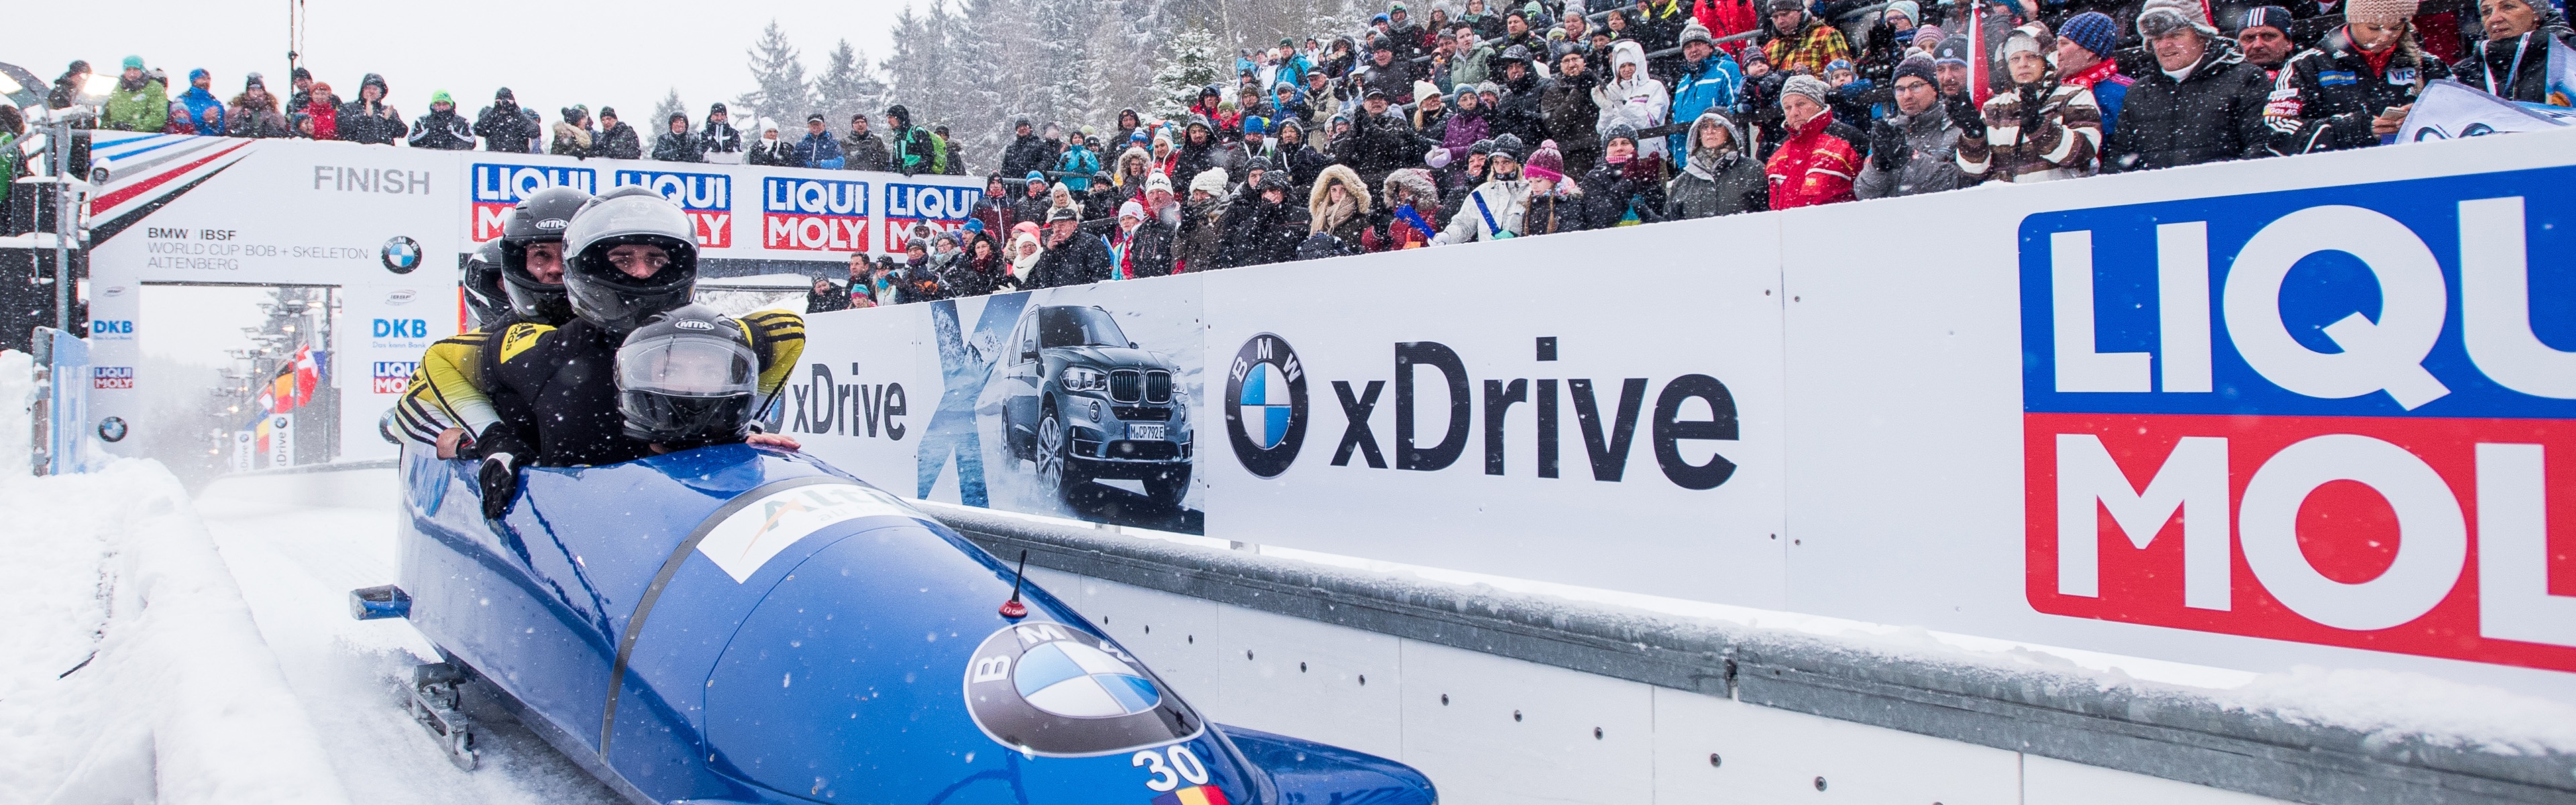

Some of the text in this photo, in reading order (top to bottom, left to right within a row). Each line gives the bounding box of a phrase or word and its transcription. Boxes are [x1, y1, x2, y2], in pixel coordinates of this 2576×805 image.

[2392, 70, 2415, 80] VIS
[314, 166, 430, 195] FINISH
[478, 167, 591, 201] LIQUI
[769, 180, 864, 215] LIQUI
[148, 227, 236, 240] BMW IBSF
[686, 213, 730, 244] LY
[768, 216, 867, 248] MOLY
[148, 242, 204, 254] WORLD
[209, 244, 239, 255] CUP
[245, 245, 276, 256] BOB
[292, 246, 368, 260] SKELETON
[384, 237, 419, 251] BMW
[148, 257, 238, 270] ALTENBERG
[2051, 197, 2576, 411] LIQU
[94, 320, 133, 333] DKB
[373, 319, 427, 337] DKB
[95, 368, 131, 378] LIQUI
[376, 362, 420, 377] LIQU
[1232, 337, 1301, 384] BMW
[95, 378, 132, 388] MOLY
[792, 362, 906, 441] xDrive
[1330, 336, 1739, 490] xDrive
[2056, 433, 2576, 647] MOL
[973, 625, 1138, 684] BMW
[1131, 745, 1209, 792] 30
